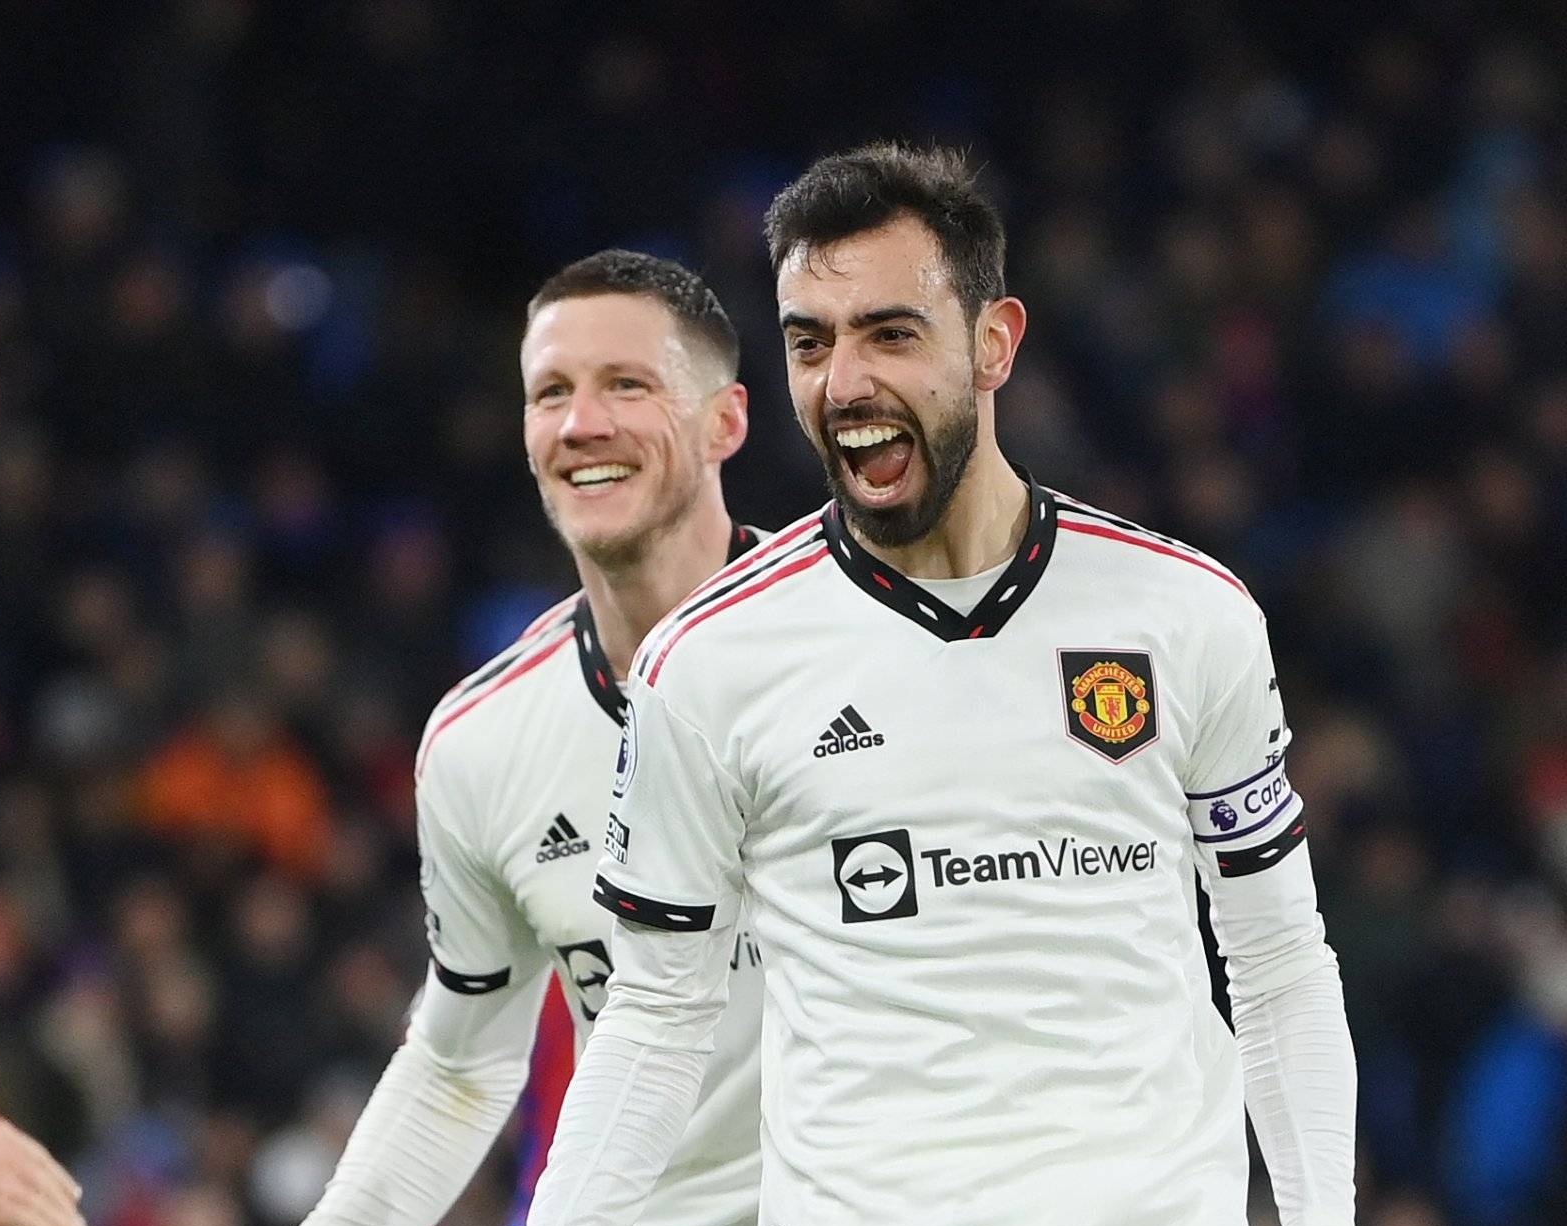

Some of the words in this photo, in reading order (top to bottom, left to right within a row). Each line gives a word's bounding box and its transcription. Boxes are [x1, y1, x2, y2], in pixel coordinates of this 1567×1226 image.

[1079, 667, 1142, 695] MANCHESTER
[1093, 724, 1136, 738] UNITED
[813, 733, 885, 758] adidas
[920, 837, 1157, 888] TeamViewer
